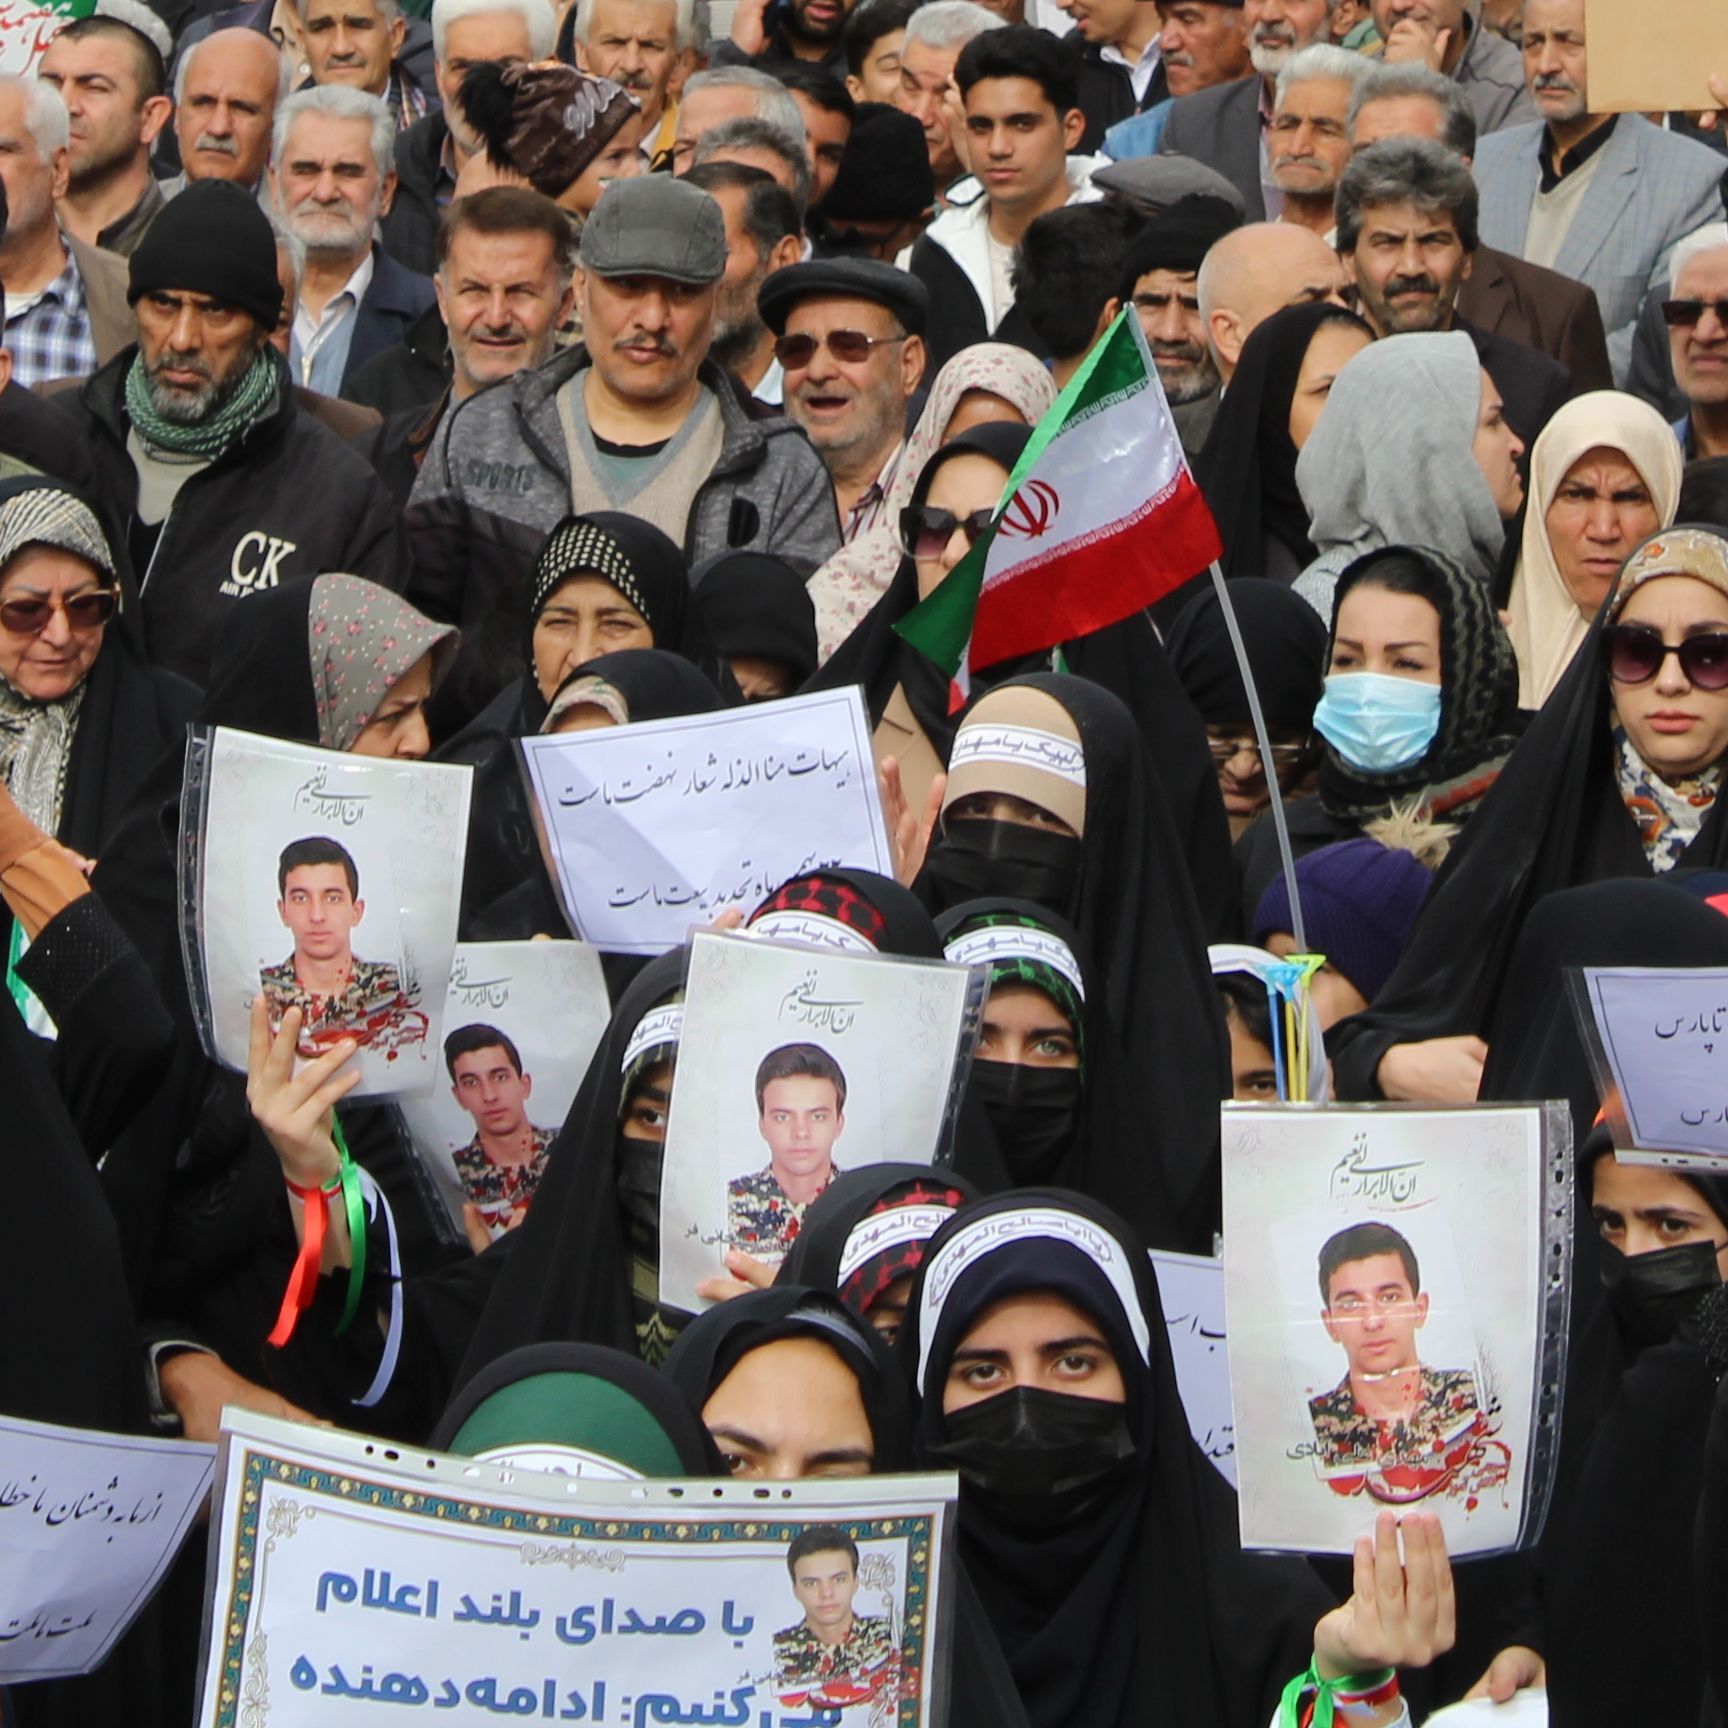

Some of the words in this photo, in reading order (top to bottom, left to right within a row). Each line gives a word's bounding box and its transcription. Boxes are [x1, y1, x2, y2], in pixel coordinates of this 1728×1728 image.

[231, 530, 297, 591] CK
[1654, 1013, 1713, 1053] پارس
[315, 1567, 439, 1618] اعلام
[452, 1590, 541, 1641] بلند
[553, 1597, 706, 1646] صدای
[719, 1600, 755, 1648] با
